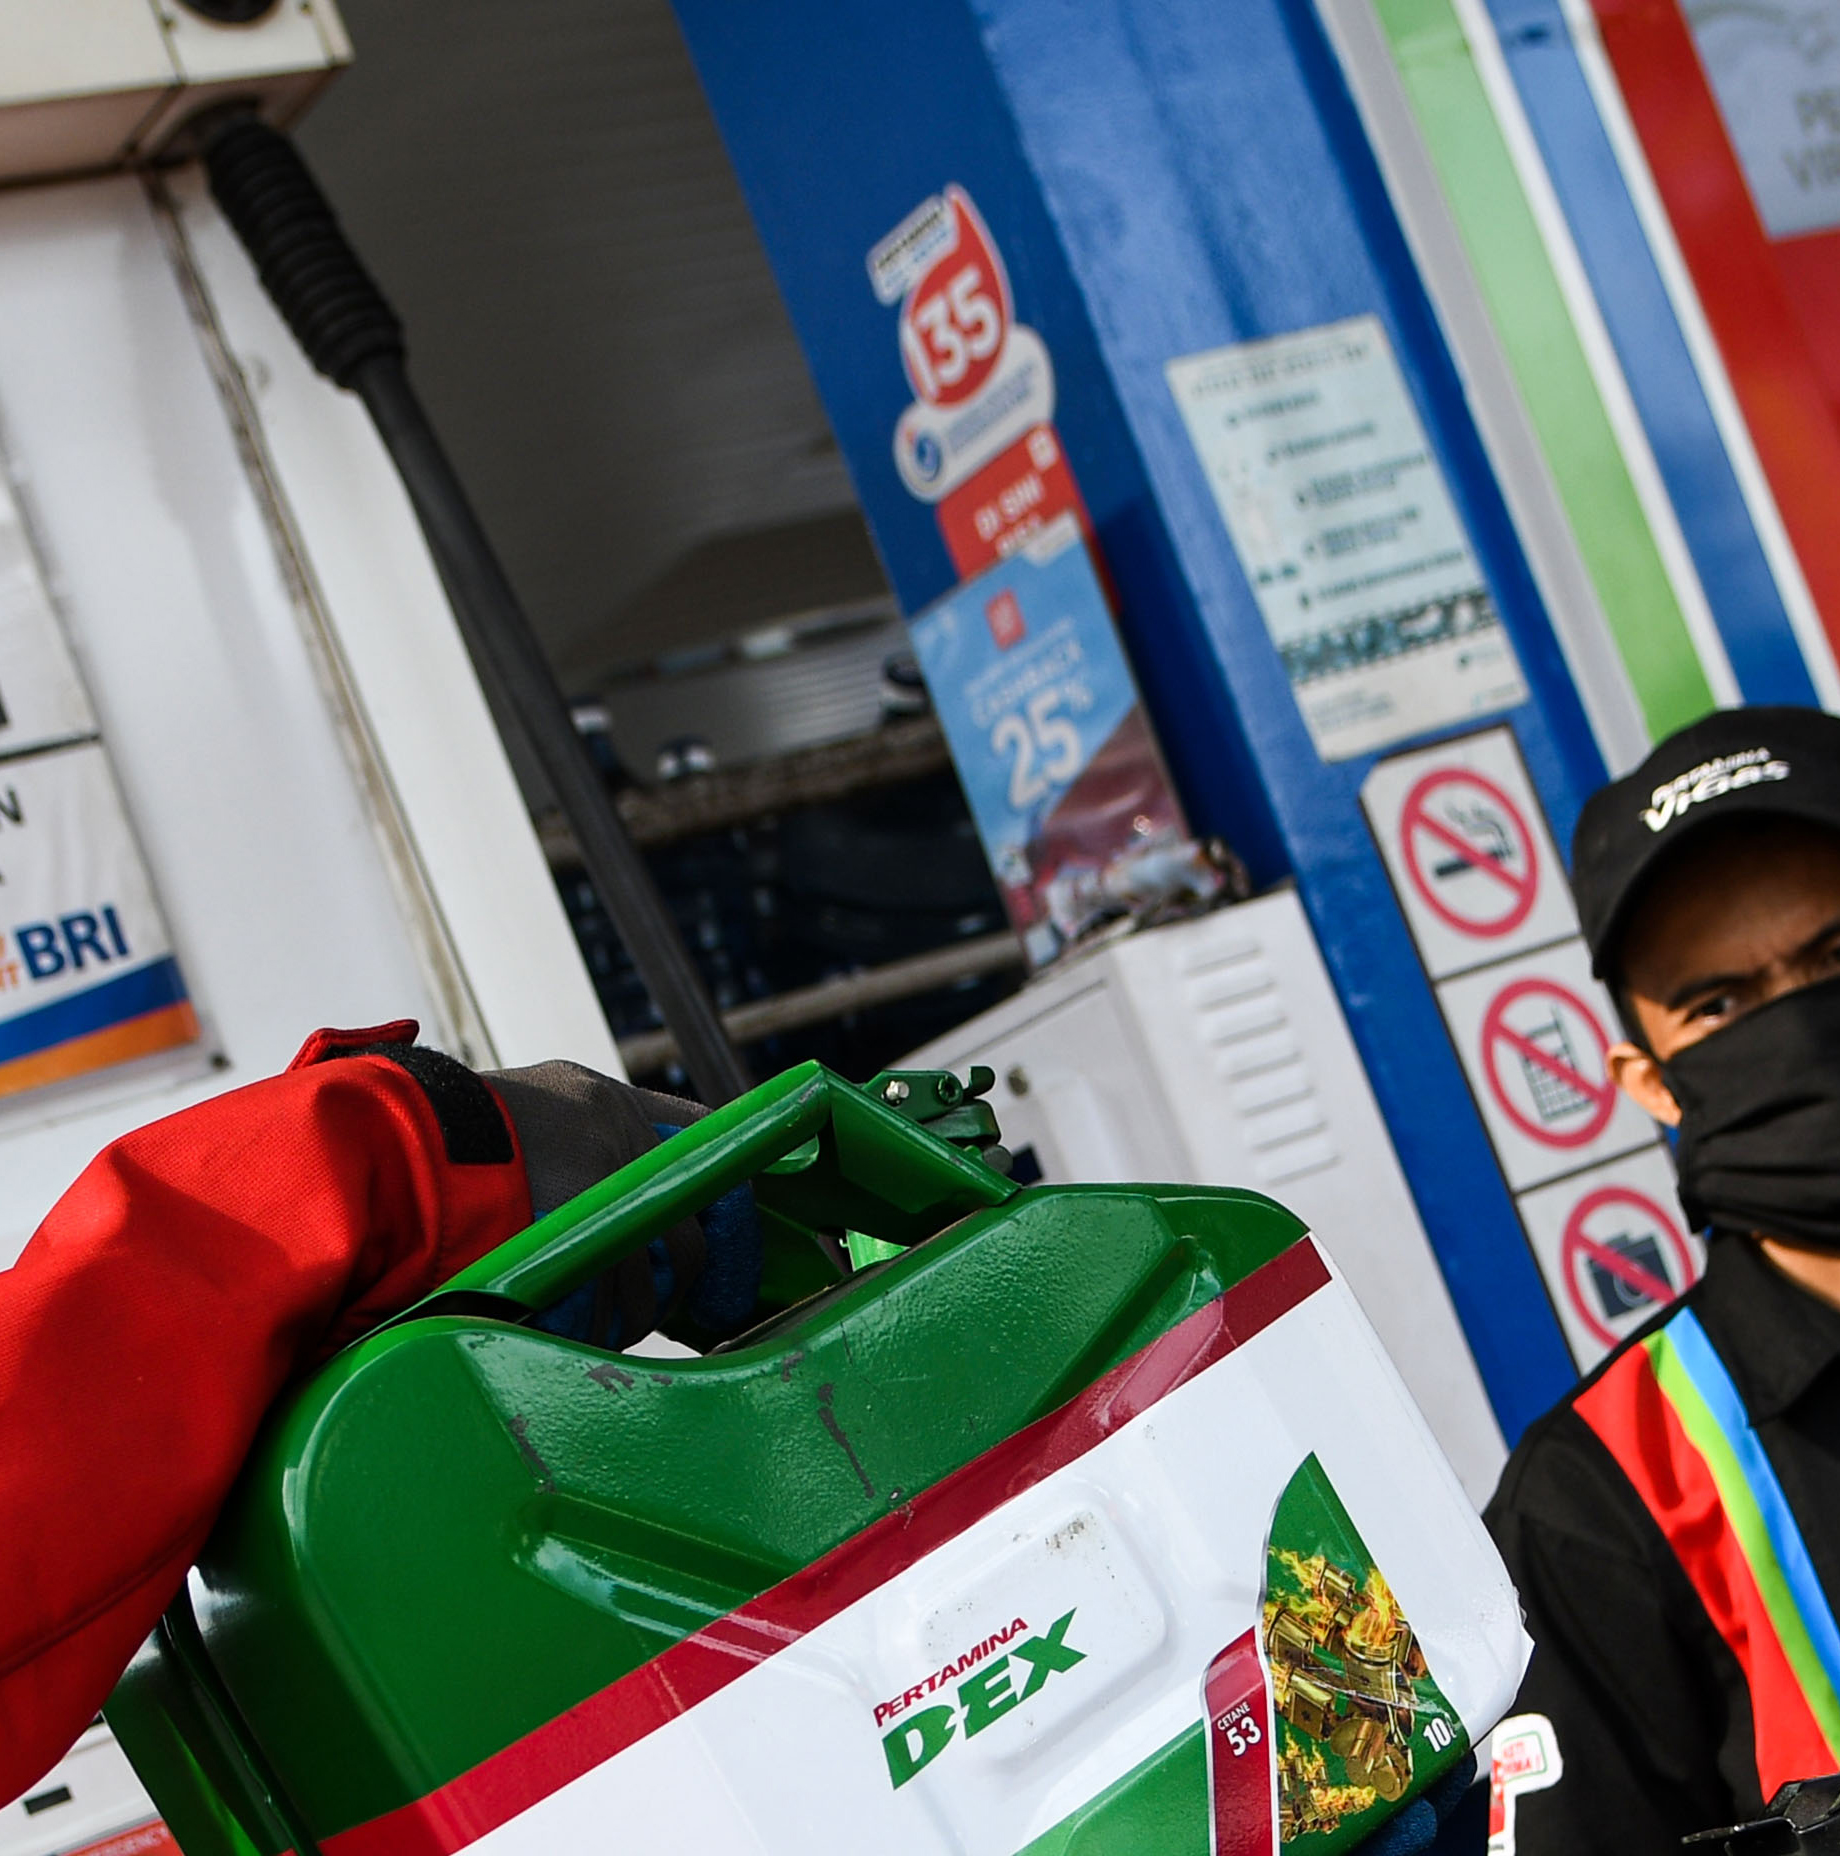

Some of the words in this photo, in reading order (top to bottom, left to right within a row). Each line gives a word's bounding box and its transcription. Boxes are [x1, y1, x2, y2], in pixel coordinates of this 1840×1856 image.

[906, 265, 1001, 398] 135
[14, 906, 132, 983] BRI
[872, 1616, 1030, 1728] PERTAMINA
[881, 1606, 1089, 1792] DEX
[1216, 1700, 1252, 1732] CETANE
[1226, 1716, 1261, 1758] 53
